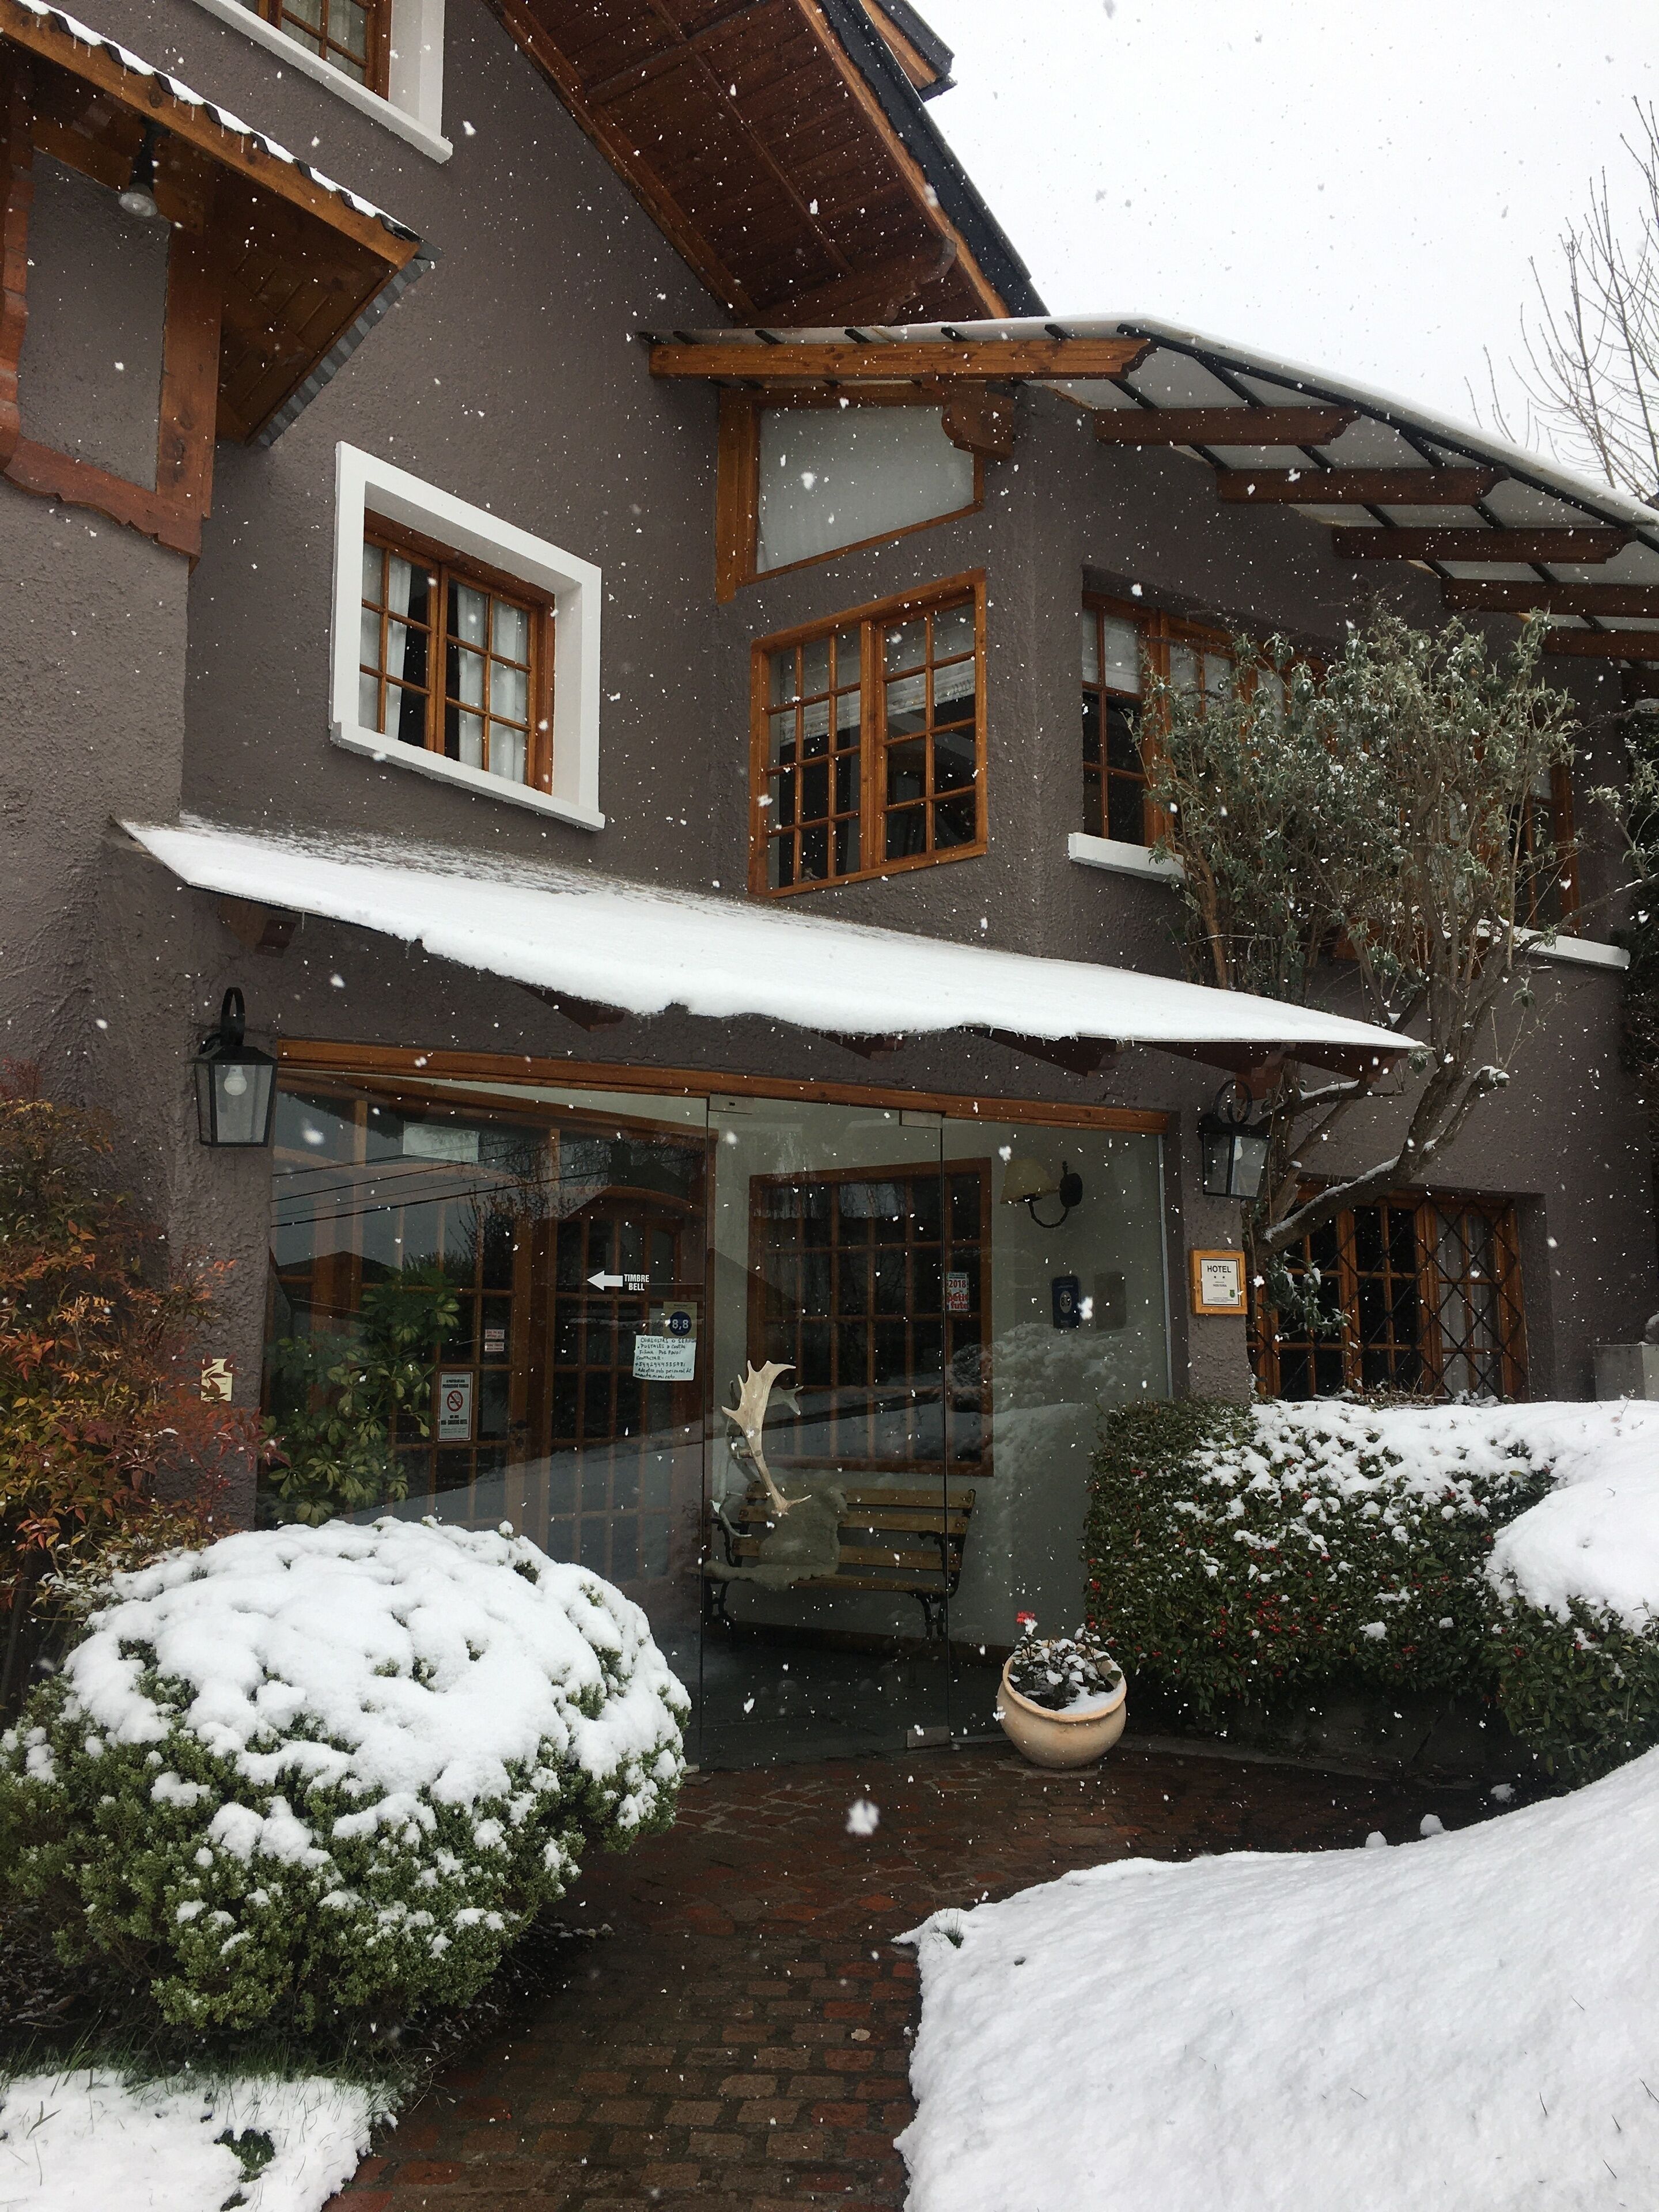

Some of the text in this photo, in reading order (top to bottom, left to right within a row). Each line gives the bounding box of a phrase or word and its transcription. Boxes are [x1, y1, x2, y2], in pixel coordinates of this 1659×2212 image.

[1207, 1265, 1232, 1273] HOTEL
[624, 1274, 650, 1283] TIMBRE
[628, 1283, 645, 1291] BELL
[949, 1279, 966, 1288] 2018
[672, 1319, 689, 1330] 8,8
